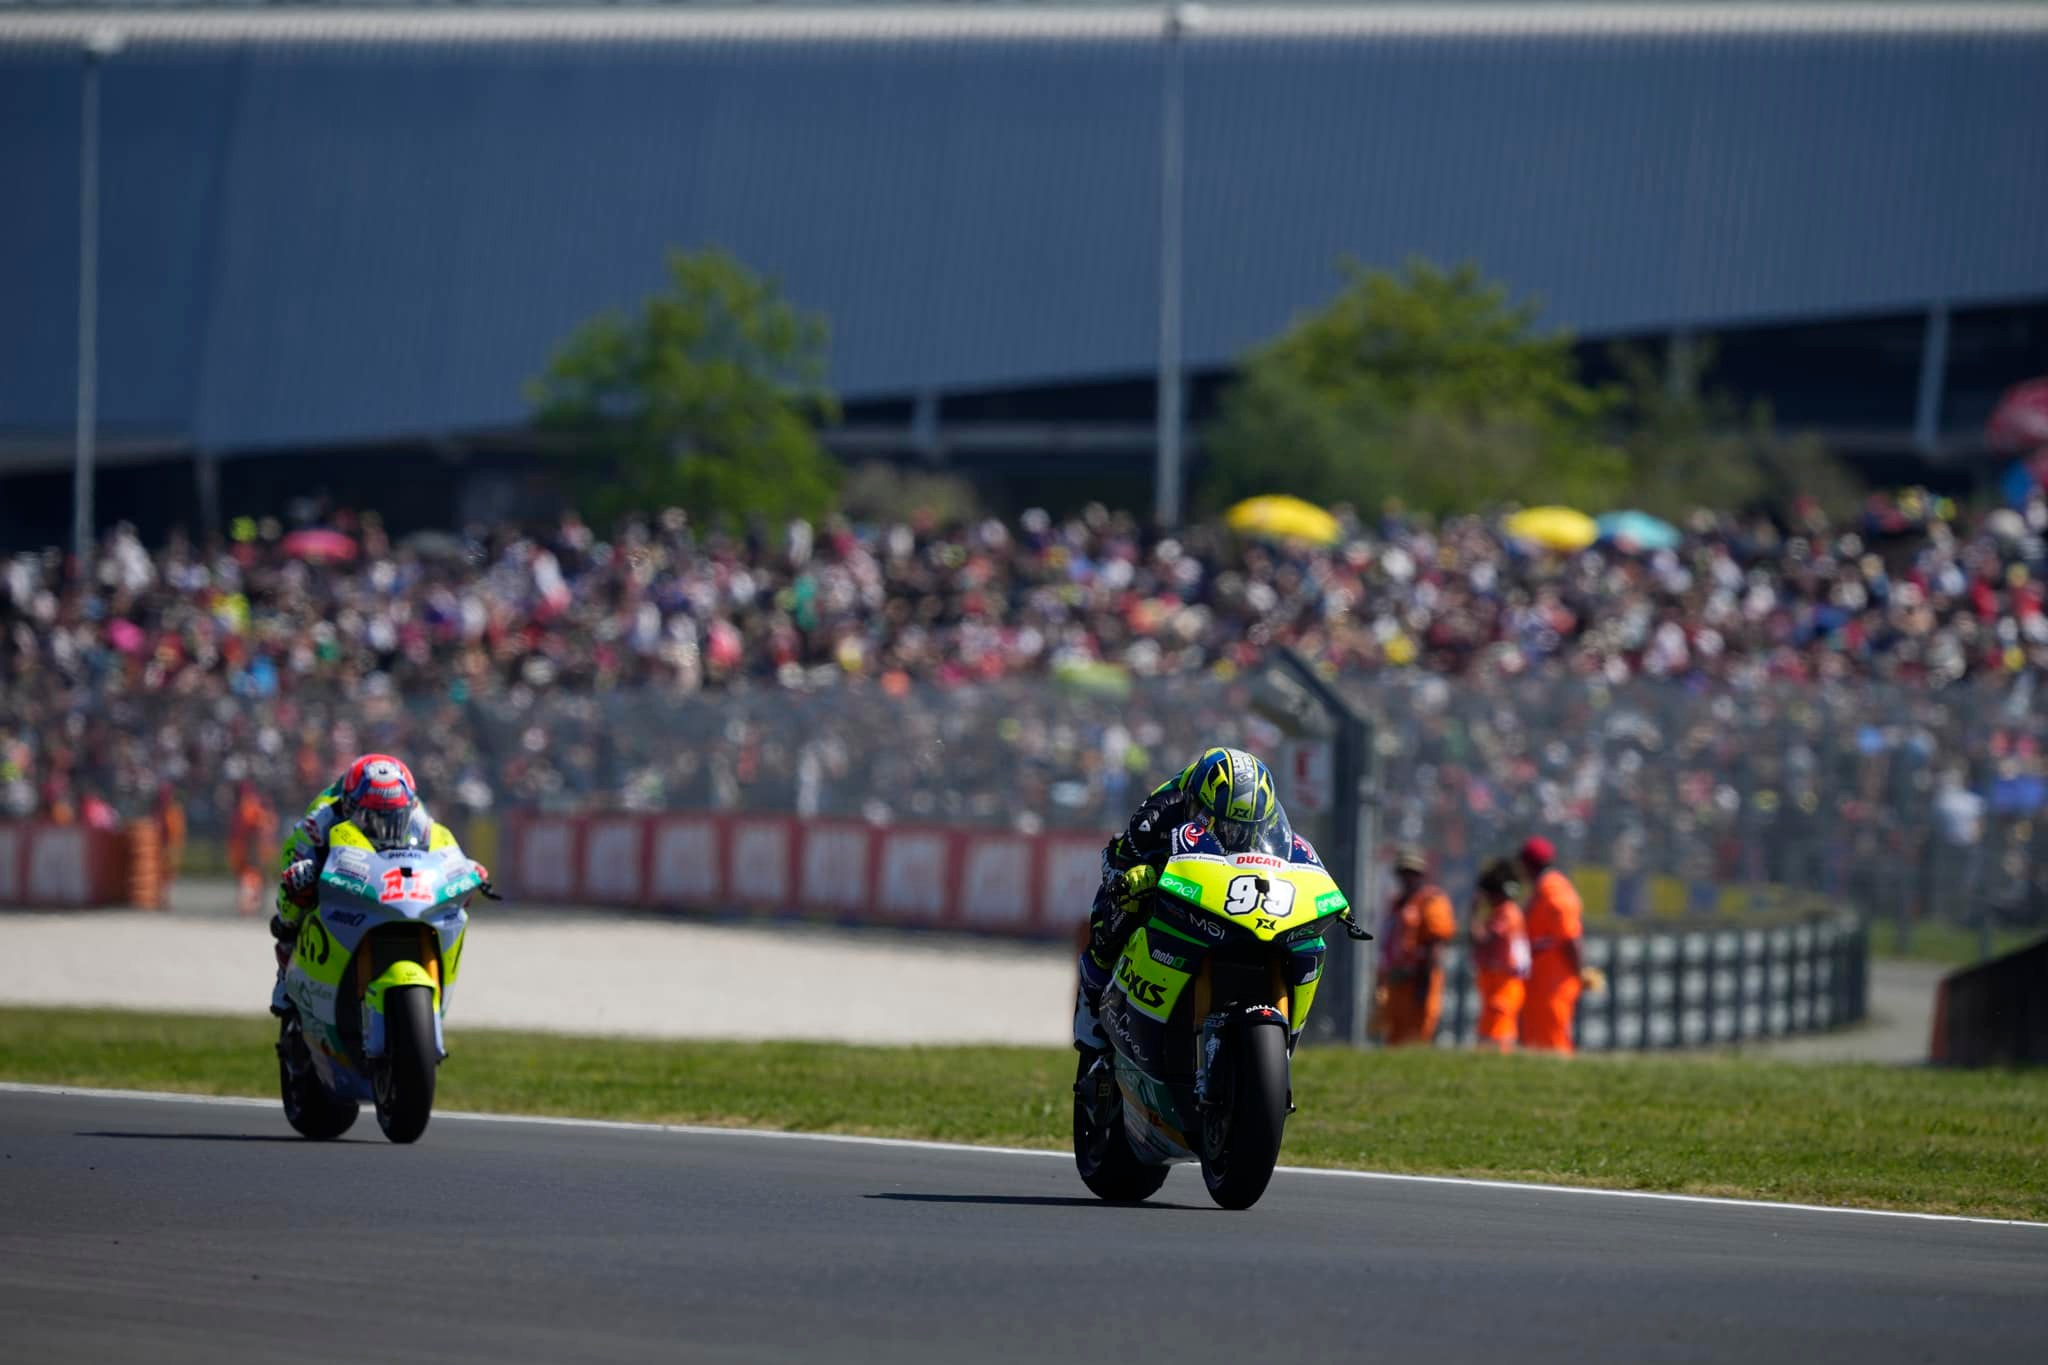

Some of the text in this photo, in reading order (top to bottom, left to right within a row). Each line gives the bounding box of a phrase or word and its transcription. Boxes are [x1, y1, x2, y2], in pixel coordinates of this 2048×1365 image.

[1236, 855, 1281, 868] DUCATI
[328, 876, 367, 896] enel
[379, 867, 437, 904] 11
[1159, 877, 1200, 899] enel
[1190, 913, 1226, 940] MSI
